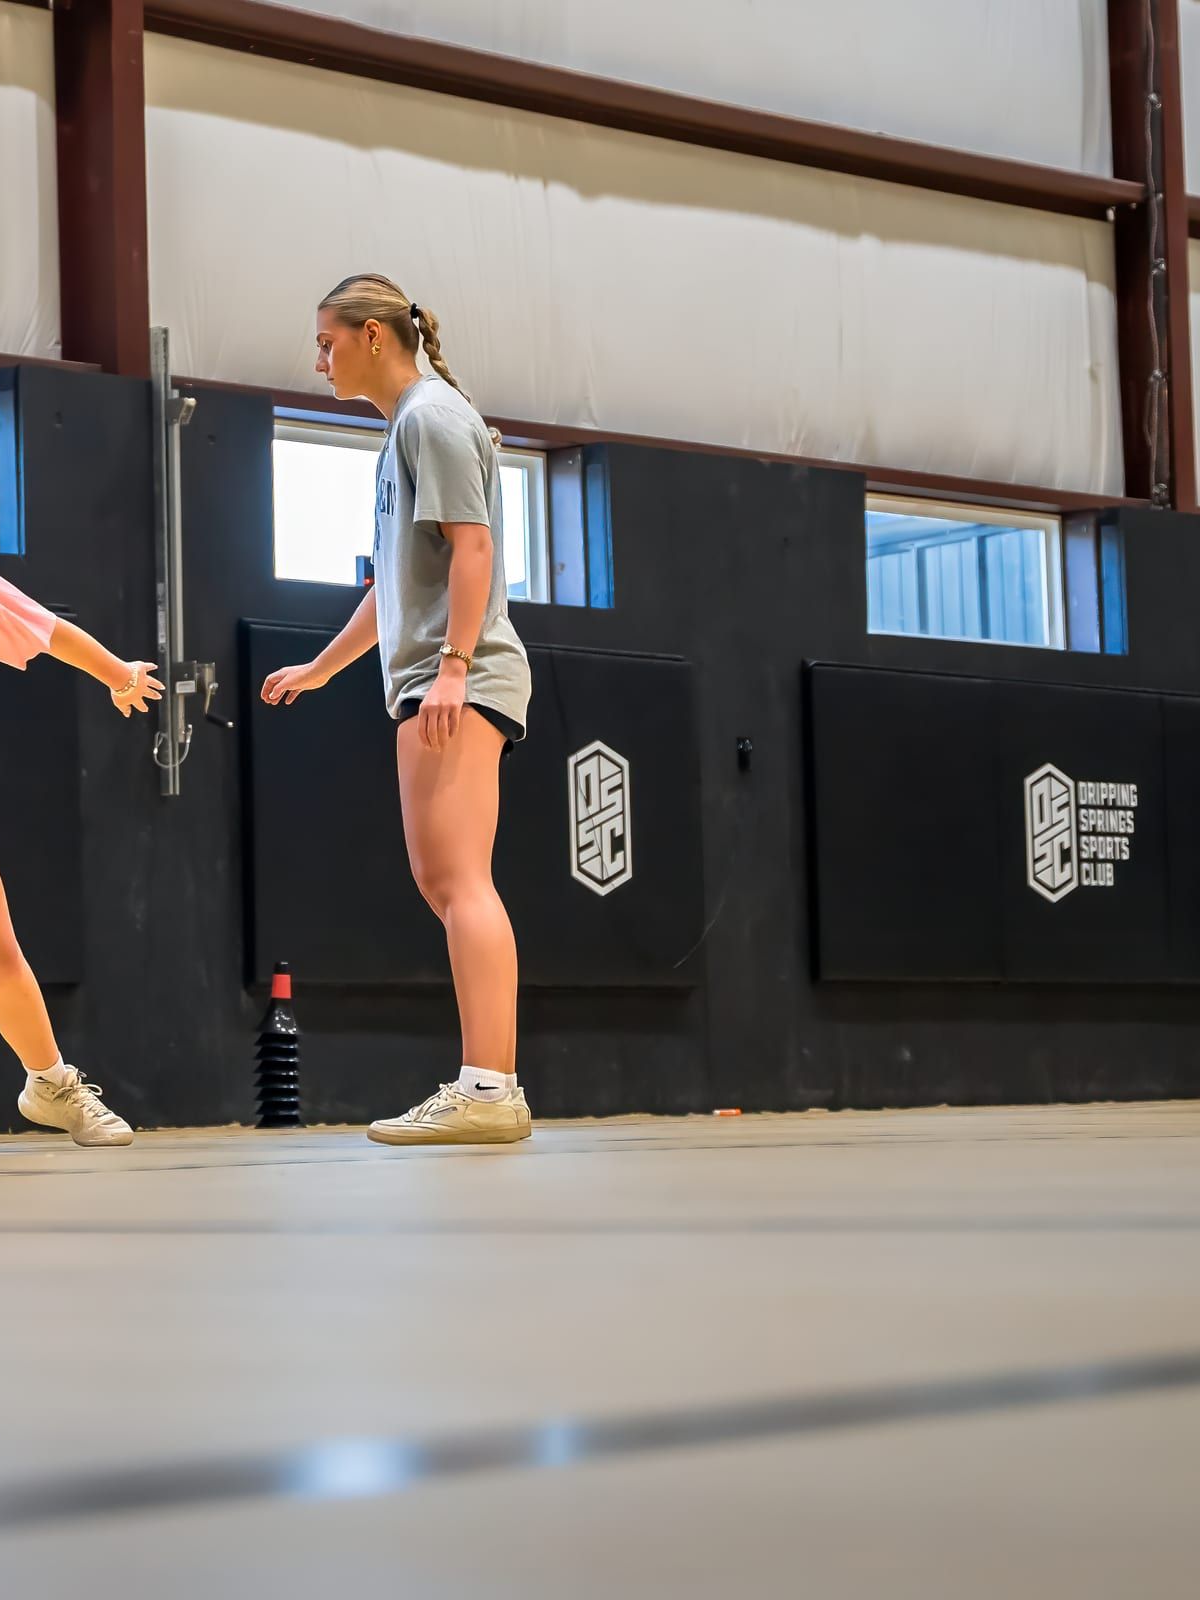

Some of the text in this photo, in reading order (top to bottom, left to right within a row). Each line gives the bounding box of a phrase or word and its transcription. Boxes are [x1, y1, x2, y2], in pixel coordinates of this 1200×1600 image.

[1079, 781, 1138, 807] DRIPPING
[1079, 808, 1135, 834] SPRINGS
[1080, 835, 1130, 861] SPORTS
[1081, 862, 1115, 887] CLUB
